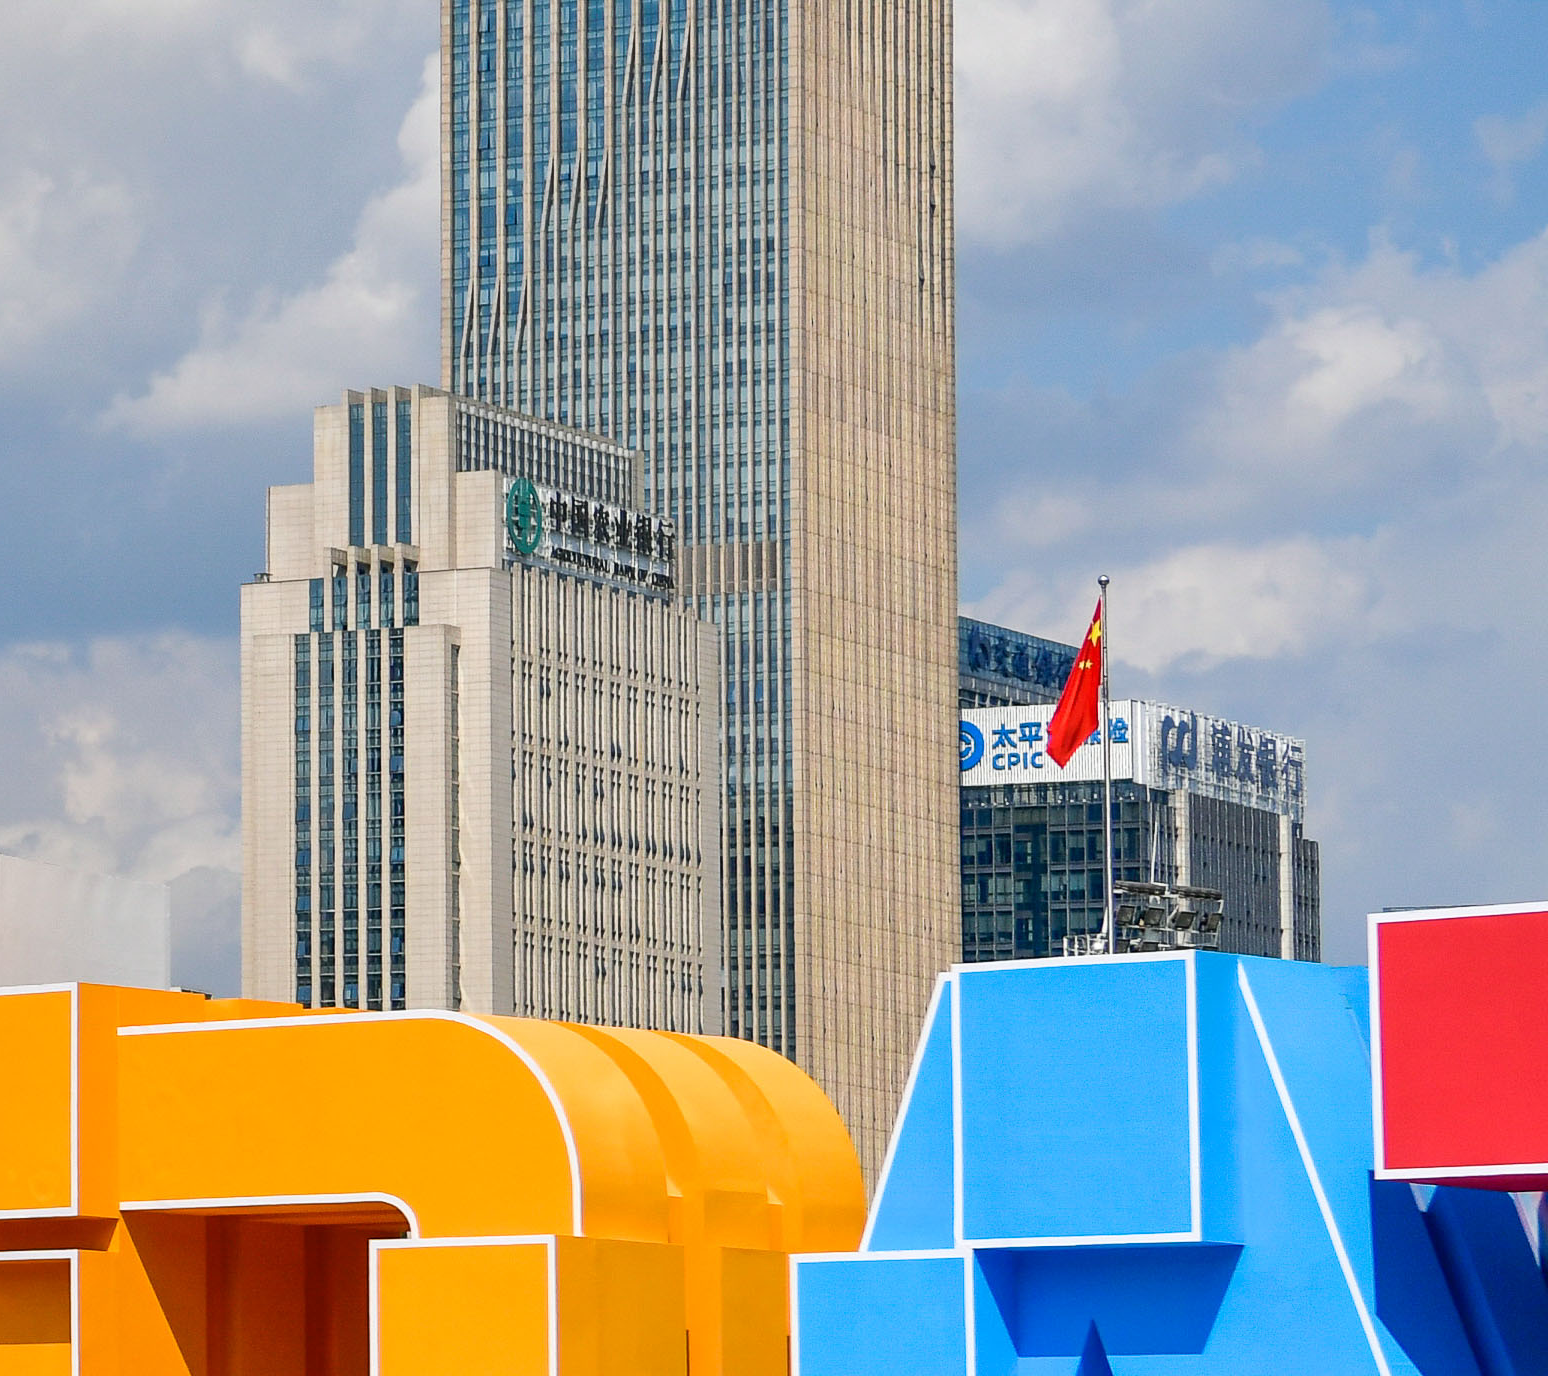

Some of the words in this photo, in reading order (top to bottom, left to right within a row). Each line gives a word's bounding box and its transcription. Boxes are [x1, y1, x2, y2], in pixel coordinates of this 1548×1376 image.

[549, 491, 676, 561] 中国农业银行
[992, 751, 1044, 771] CPIC
[1211, 721, 1304, 797] 浦发银行
